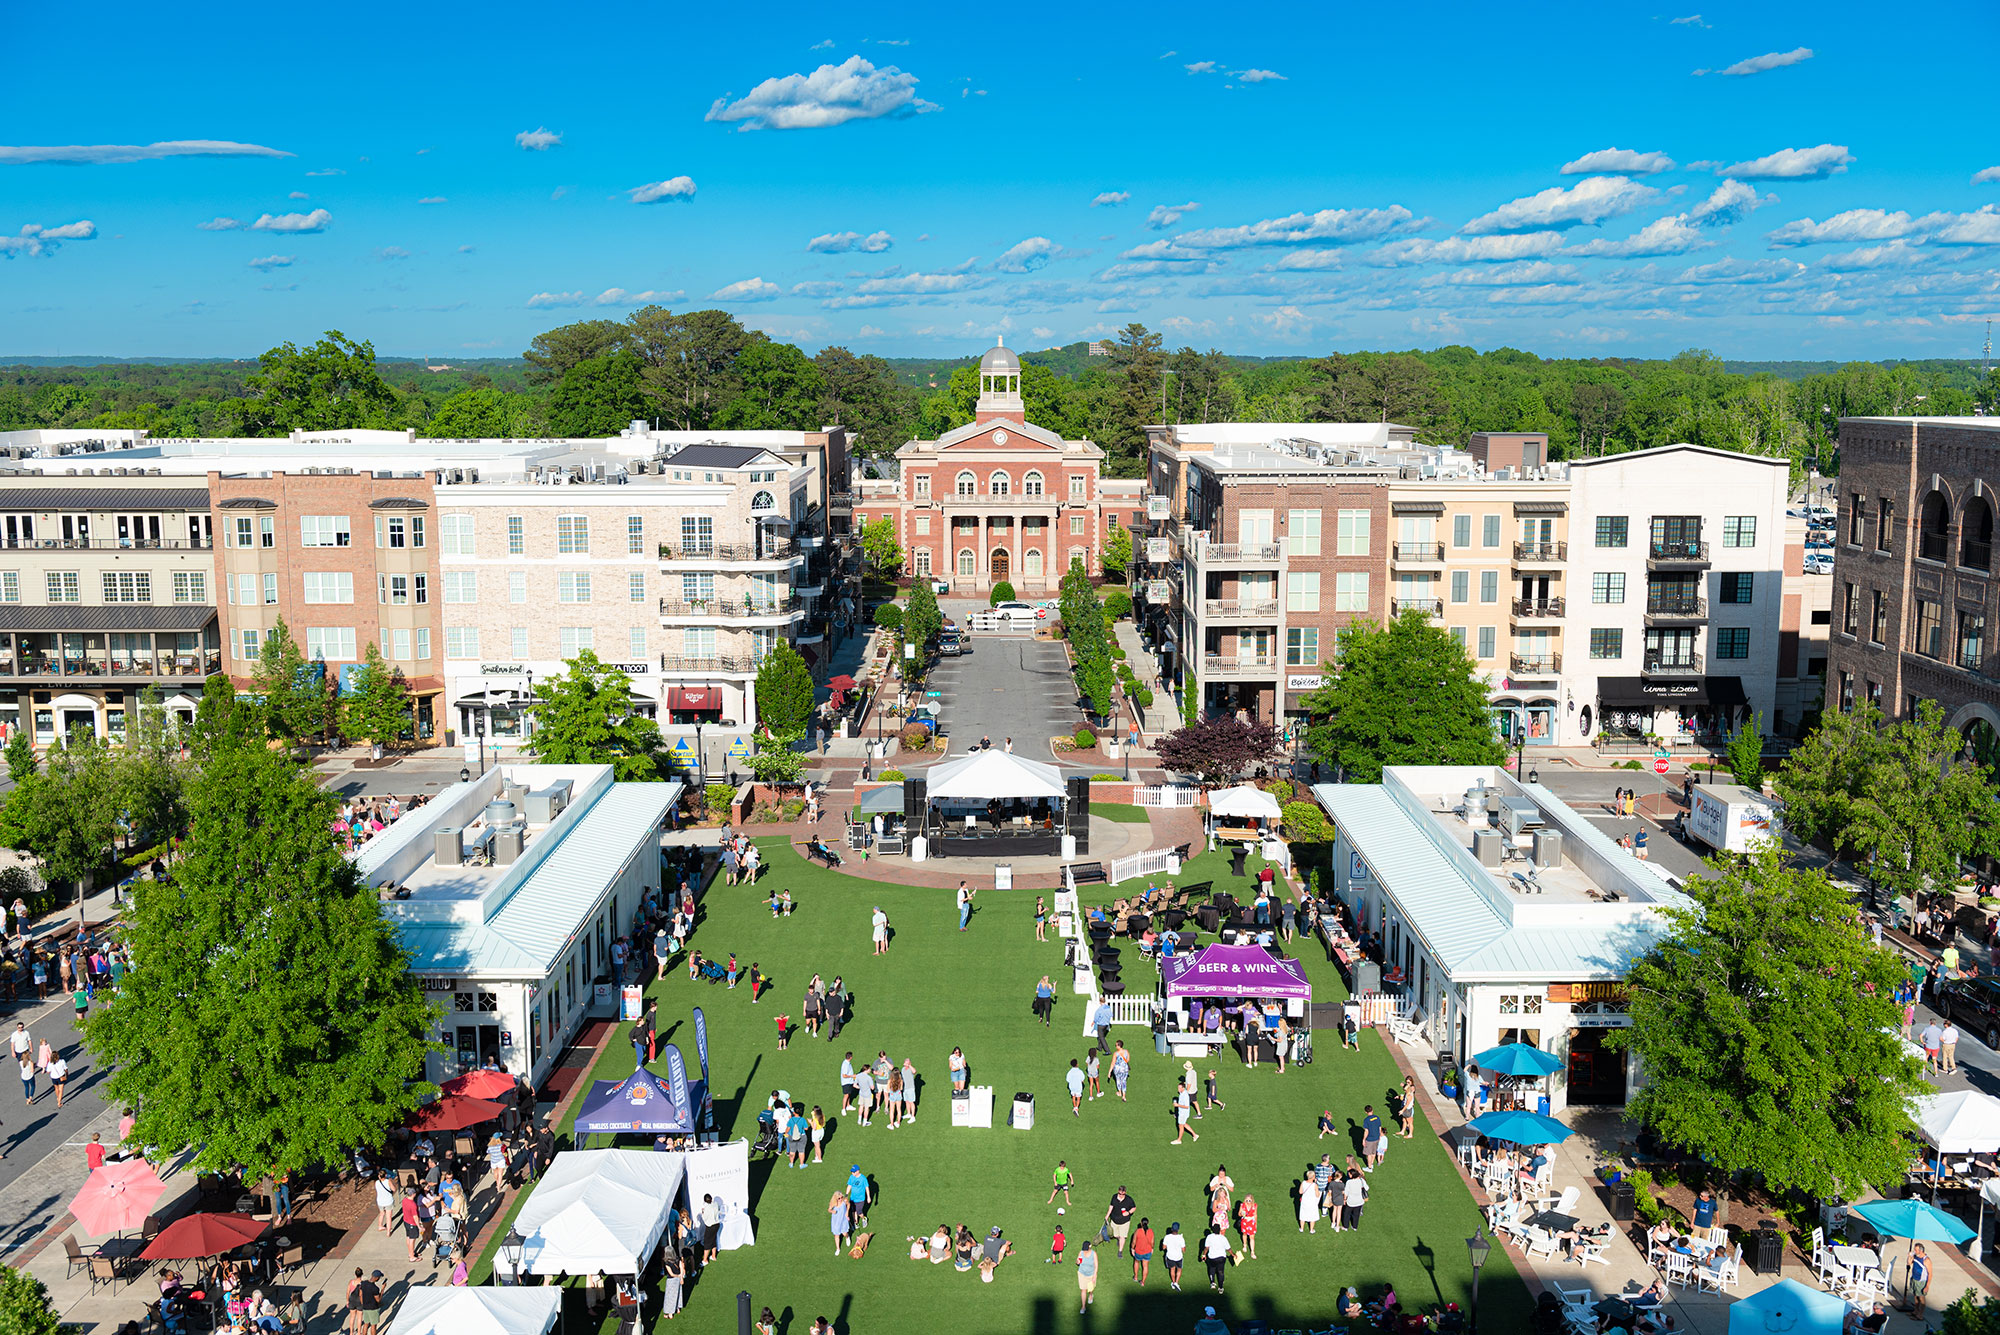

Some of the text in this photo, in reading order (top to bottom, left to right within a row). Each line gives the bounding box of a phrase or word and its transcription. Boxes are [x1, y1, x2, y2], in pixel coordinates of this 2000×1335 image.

[1703, 801, 1722, 823] Budget
[1199, 963, 1228, 973] BEER
[1232, 964, 1241, 973] &
[1244, 963, 1278, 973] WINE
